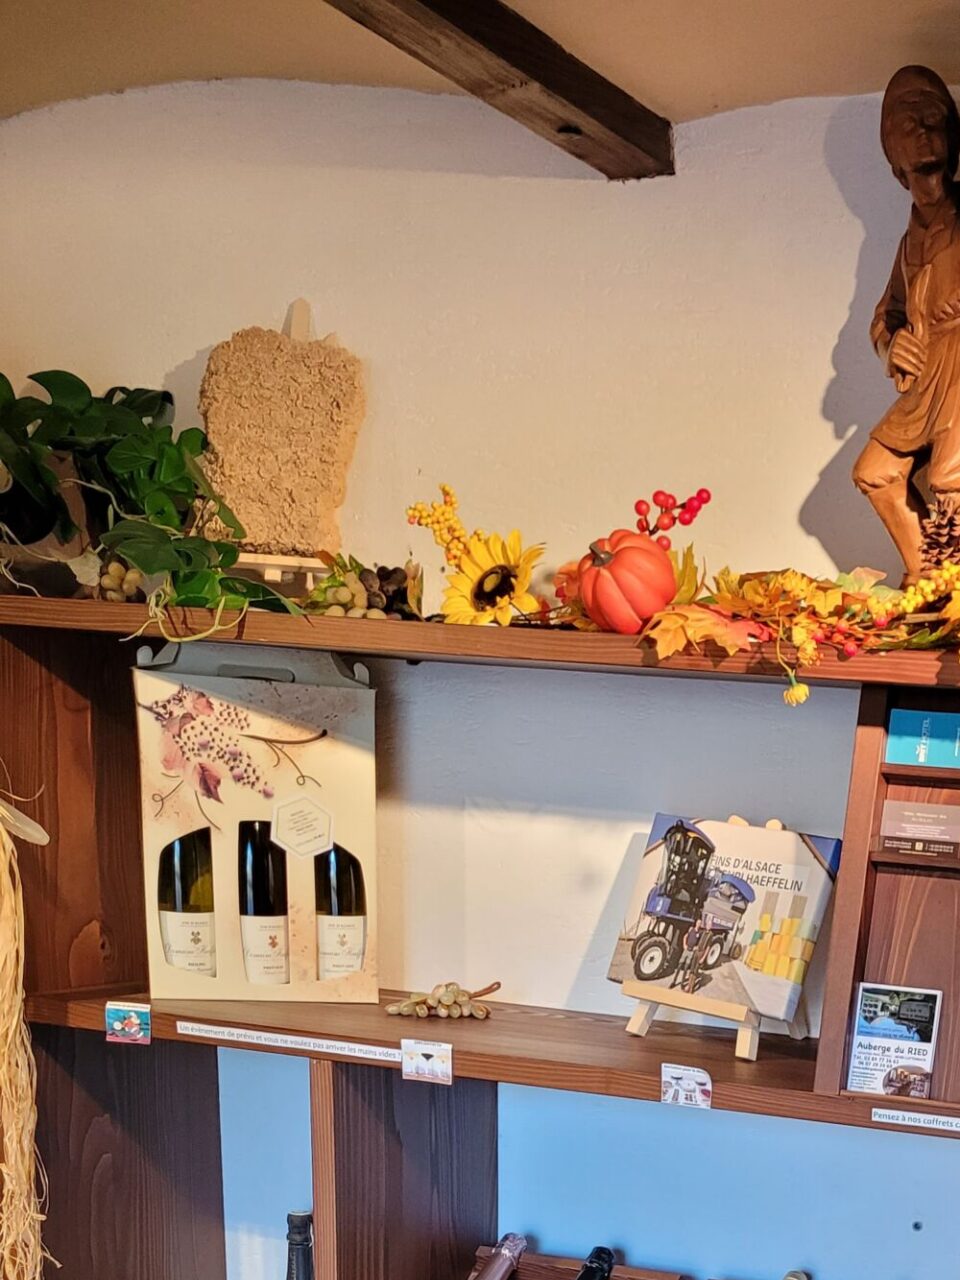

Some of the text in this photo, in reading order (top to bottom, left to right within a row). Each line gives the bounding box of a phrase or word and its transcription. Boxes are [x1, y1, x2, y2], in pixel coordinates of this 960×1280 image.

[733, 858, 783, 875] D'ALSACE
[746, 874, 803, 892] HAEFFELIN
[179, 1024, 190, 1032] Un
[236, 1031, 255, 1041] prévu
[289, 1038, 311, 1048] voulez
[312, 1042, 325, 1051] pas
[325, 1043, 346, 1052] arriver
[347, 1045, 357, 1054] les
[357, 1047, 377, 1056] mains
[378, 1049, 397, 1059] vides
[857, 1041, 891, 1054] Auberge
[894, 1045, 905, 1054] du
[907, 1047, 928, 1057] RIED
[873, 1110, 900, 1121] Pensez
[901, 1113, 906, 1122] à
[907, 1116, 921, 1124] nos
[922, 1117, 954, 1128] coffrets
